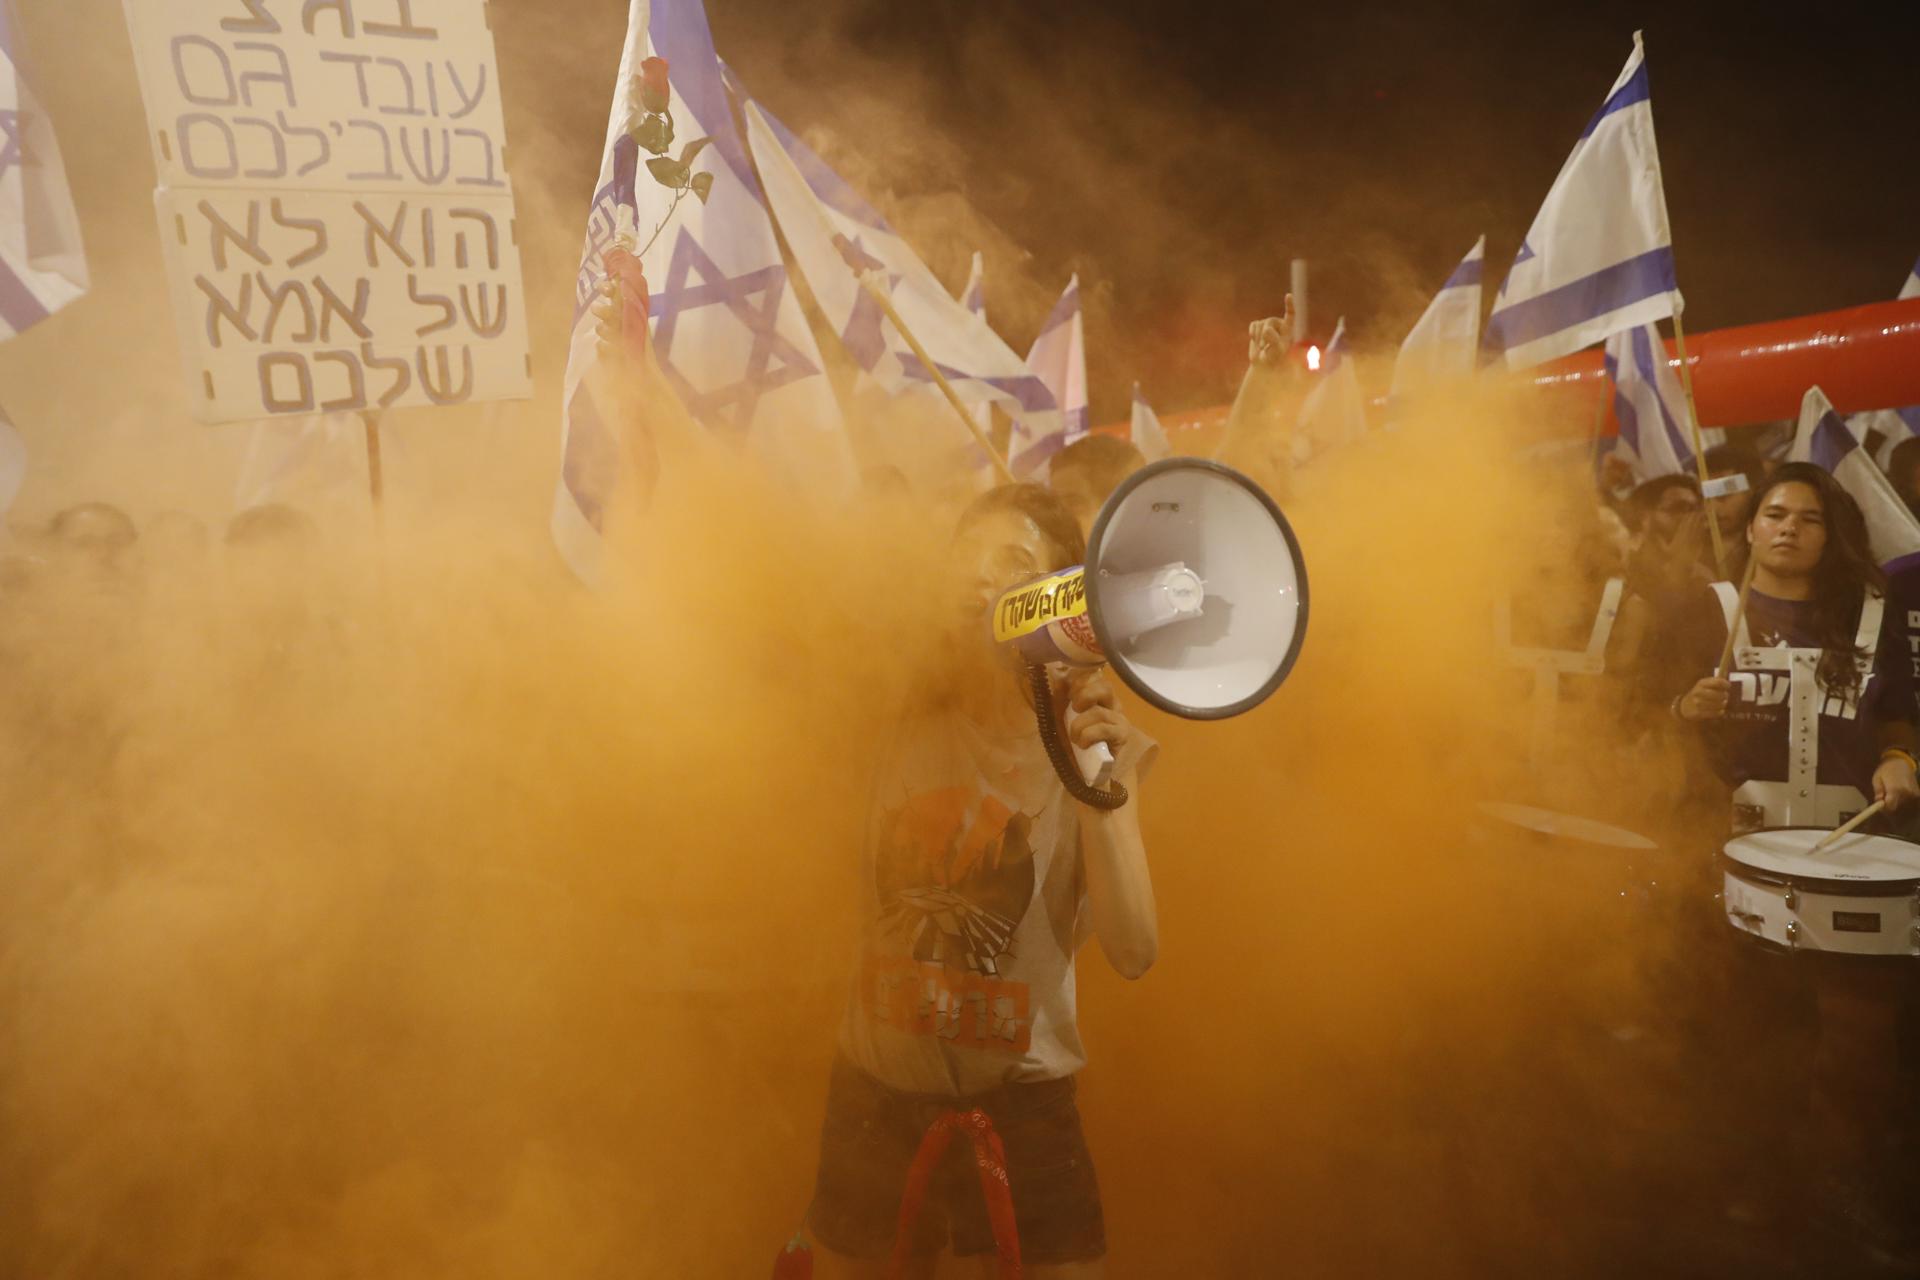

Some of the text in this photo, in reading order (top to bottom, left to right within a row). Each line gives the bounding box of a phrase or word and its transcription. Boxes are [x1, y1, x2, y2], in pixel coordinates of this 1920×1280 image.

[170, 35, 486, 119] עובד גם
[176, 110, 506, 188] בשבילכם
[197, 198, 328, 272] לא
[352, 201, 500, 270] הוא
[194, 271, 507, 348] של אמא
[257, 341, 474, 413] שלכם
[1002, 587, 1042, 632] שקרן
